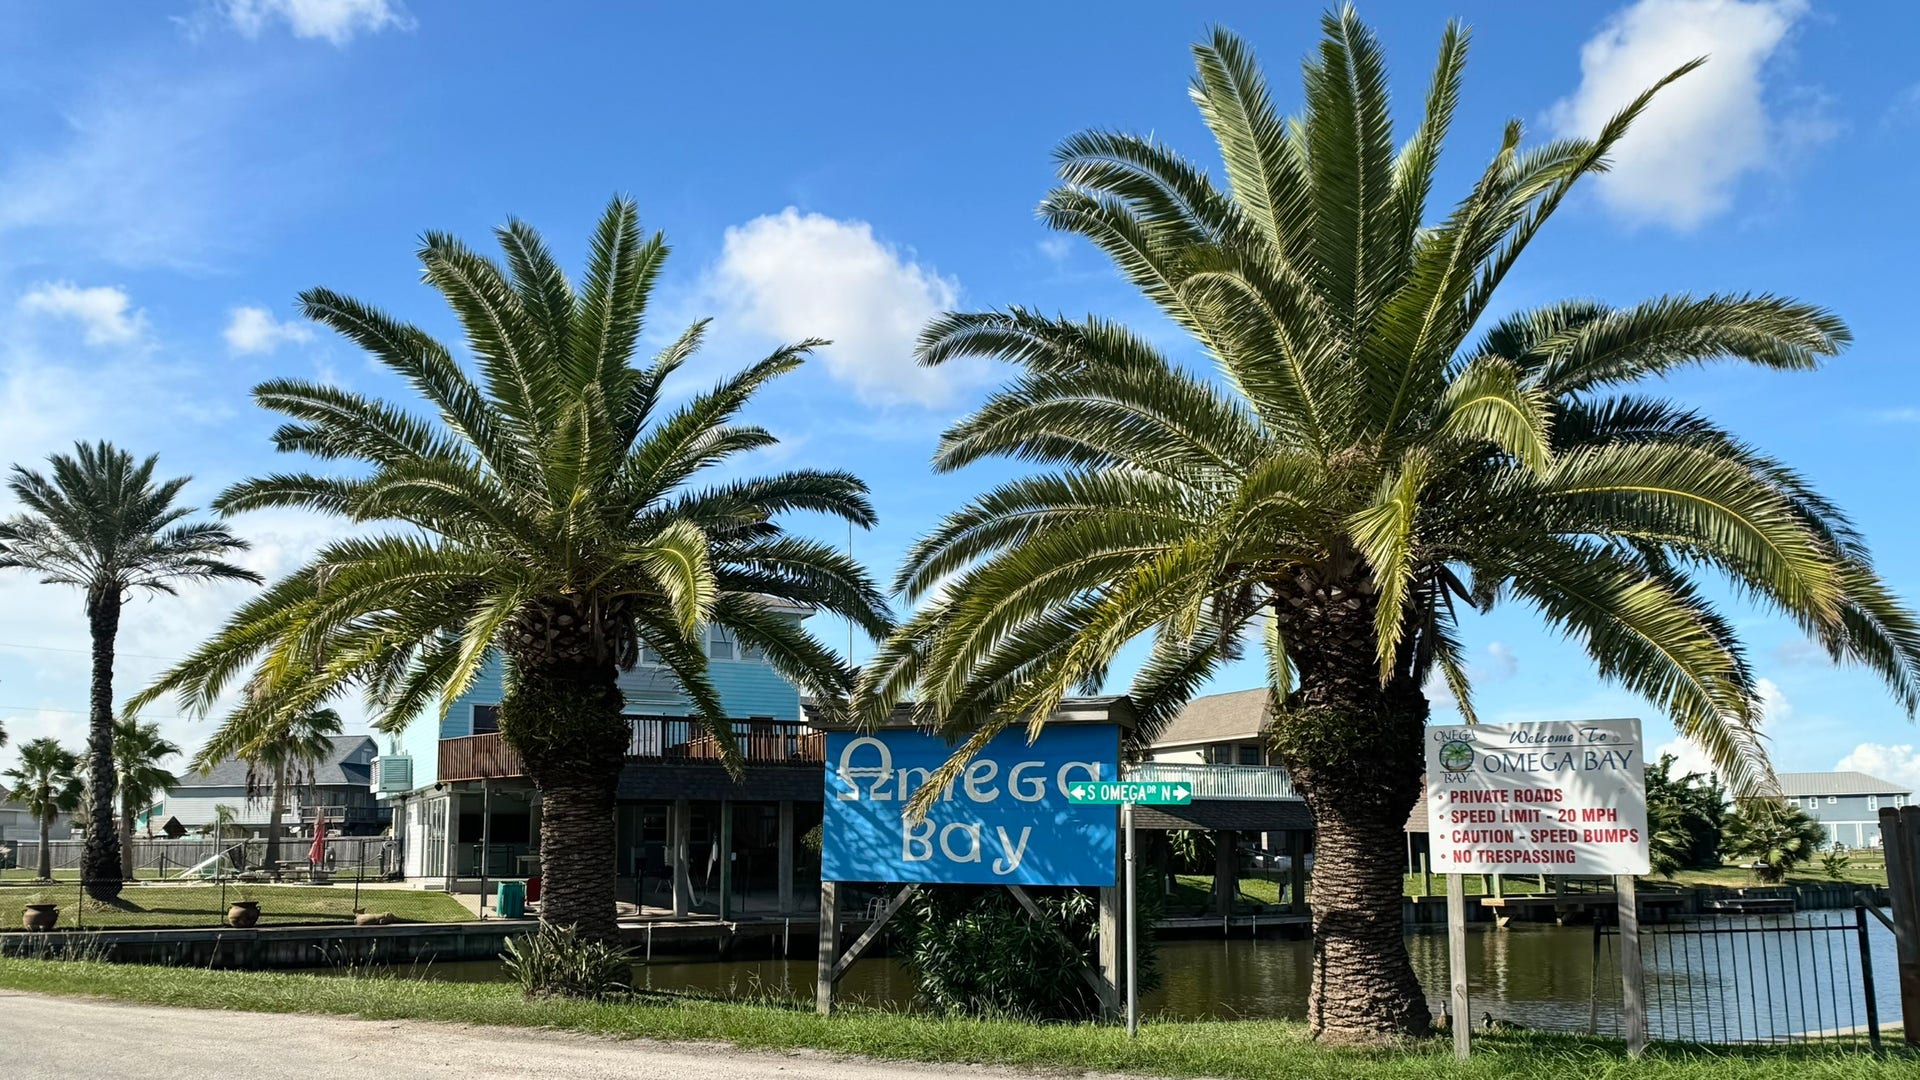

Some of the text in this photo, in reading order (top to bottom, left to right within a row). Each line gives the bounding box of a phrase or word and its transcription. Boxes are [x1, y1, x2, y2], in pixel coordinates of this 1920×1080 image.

[1433, 729, 1477, 741] OMEGA
[1509, 727, 1607, 744] Welcome To
[1483, 749, 1633, 773] OMEGA BAY
[1444, 772, 1470, 784] BAY
[1087, 785, 1171, 801] S OMEGA DR N
[1450, 788, 1563, 803] PRIVATE ROADS
[1451, 810, 1495, 823] SPEED
[1502, 809, 1541, 823] LIMIT
[1558, 809, 1577, 822] 20
[1582, 808, 1617, 822] MPH
[1452, 830, 1514, 843] CAUTION
[1531, 829, 1578, 843] SPEED
[1583, 828, 1639, 843] BUMPS
[902, 816, 1031, 876] Bay
[1453, 849, 1576, 864] NO TRESPASSING
